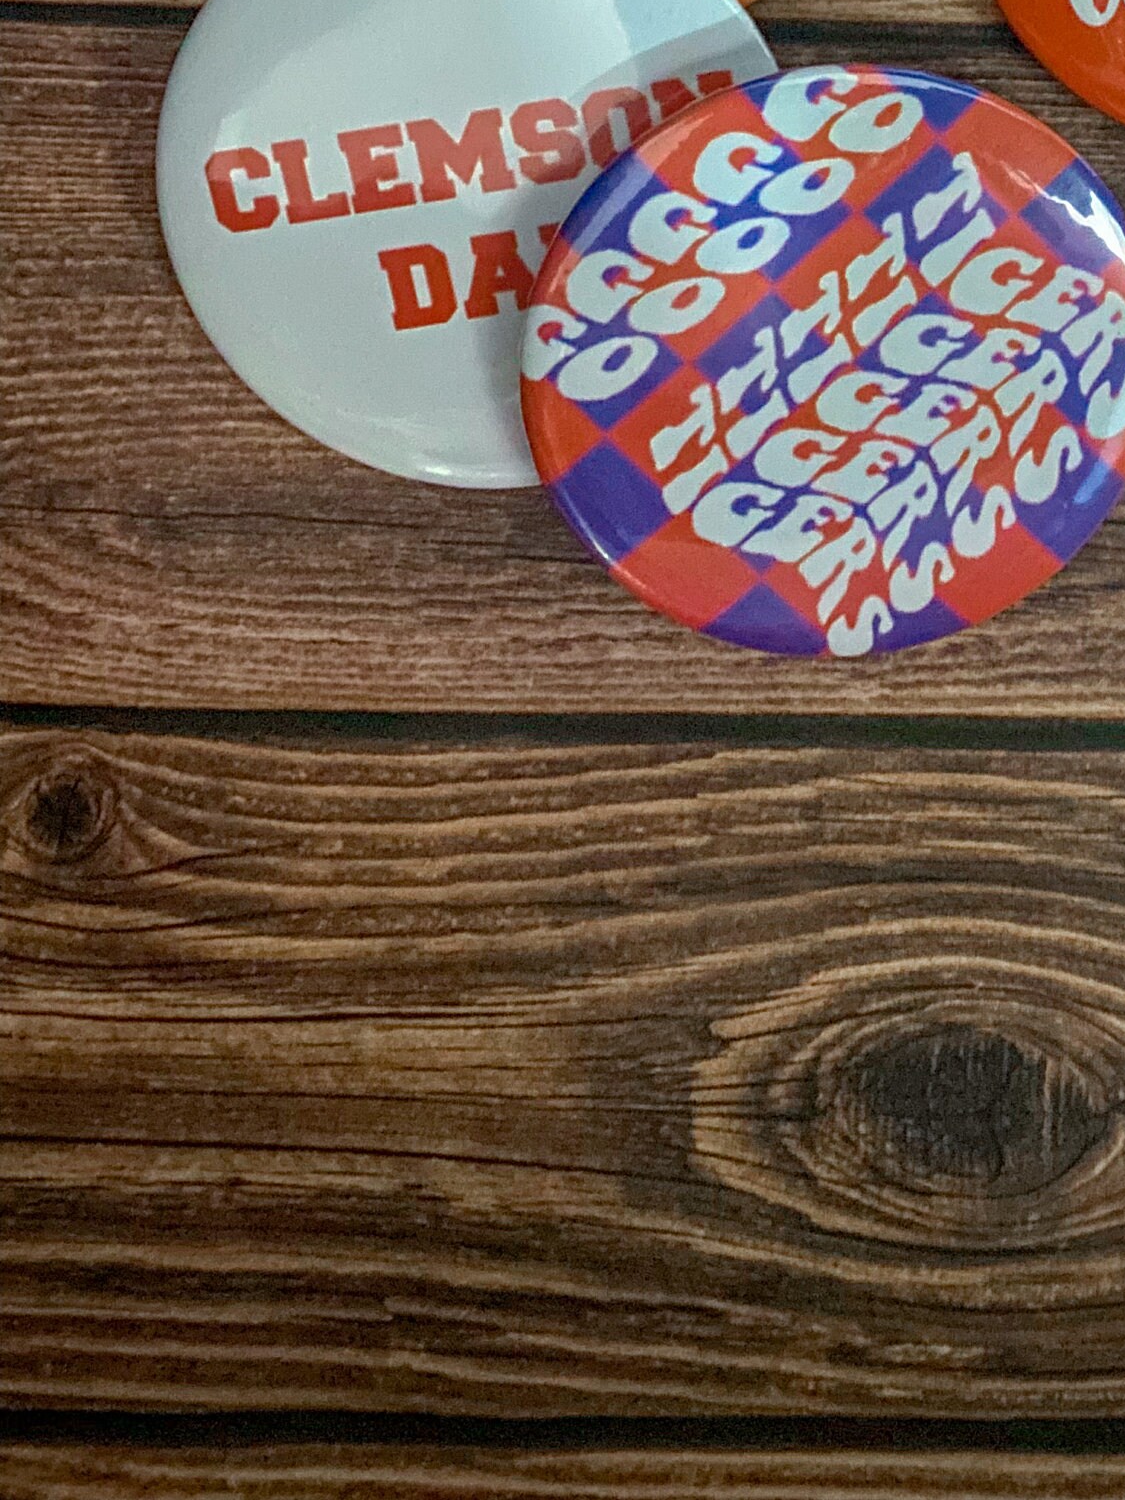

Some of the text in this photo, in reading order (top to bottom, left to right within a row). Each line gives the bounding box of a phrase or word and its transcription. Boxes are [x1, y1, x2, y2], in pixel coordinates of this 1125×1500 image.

[377, 222, 561, 332] DA
[762, 65, 924, 154] GO
[520, 304, 894, 658] GO TIGERS
[565, 249, 956, 614] GO TIGERS
[628, 190, 1018, 560] GO TIGERS
[692, 131, 1084, 505] GO TIGERS
